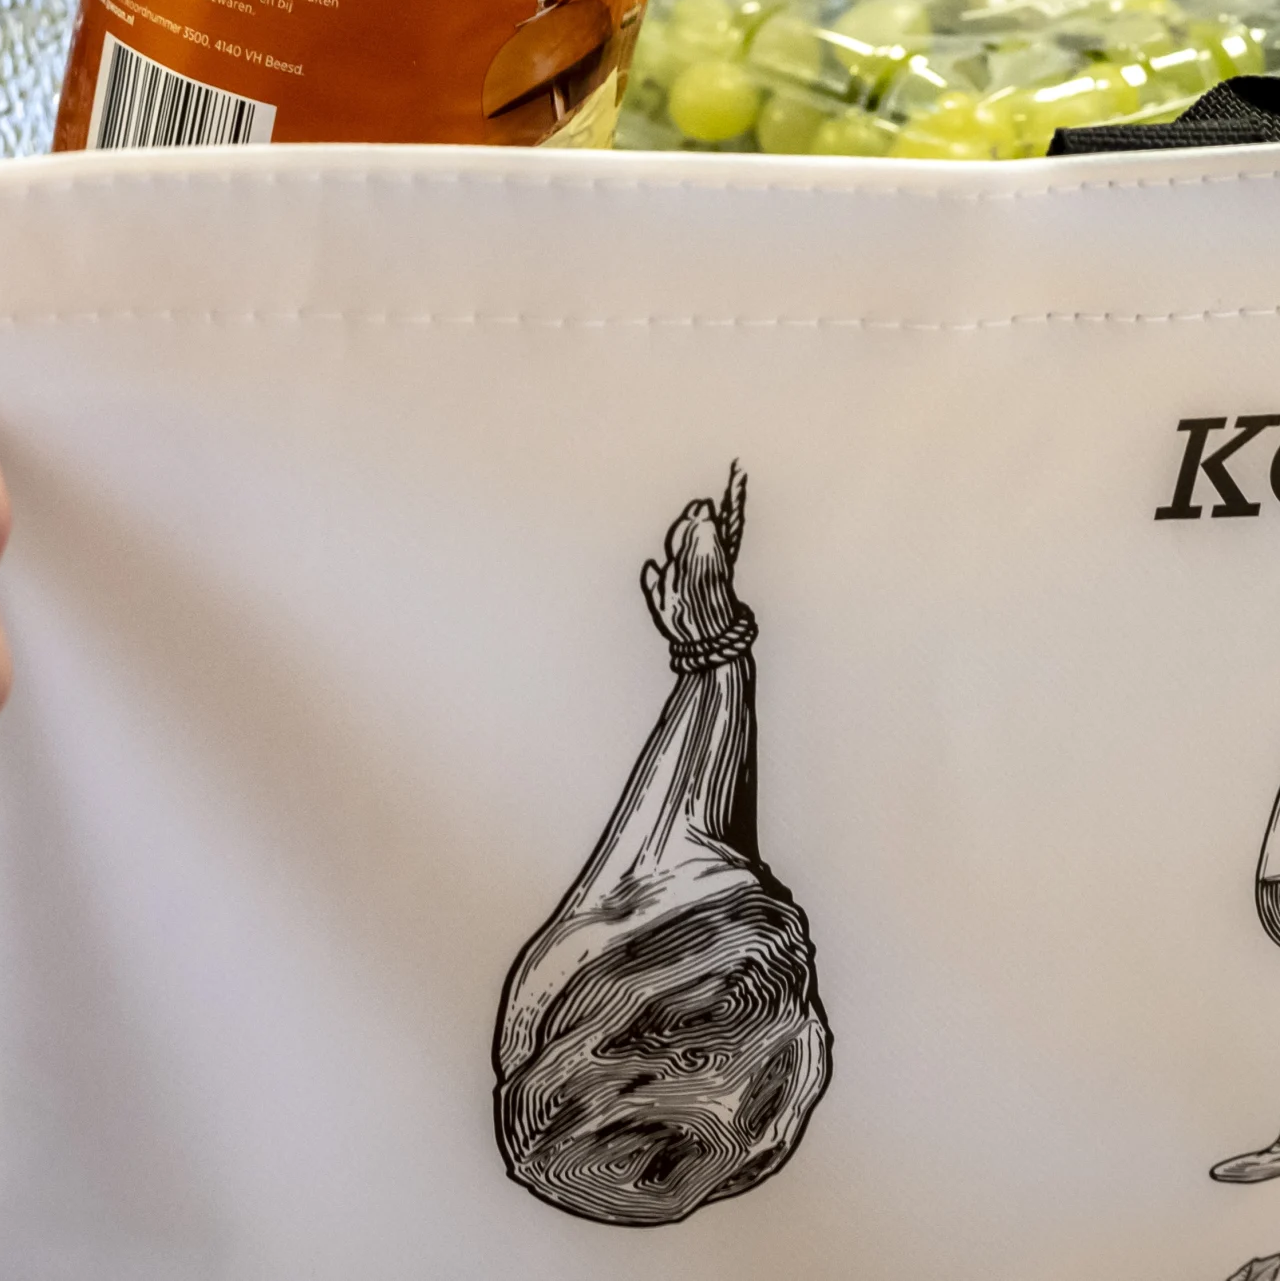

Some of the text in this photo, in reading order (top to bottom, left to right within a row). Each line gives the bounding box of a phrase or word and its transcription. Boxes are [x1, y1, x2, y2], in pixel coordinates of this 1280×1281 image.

[214, 38, 242, 58] 4140
[244, 47, 262, 65] VH
[264, 54, 306, 77] Beesd.
